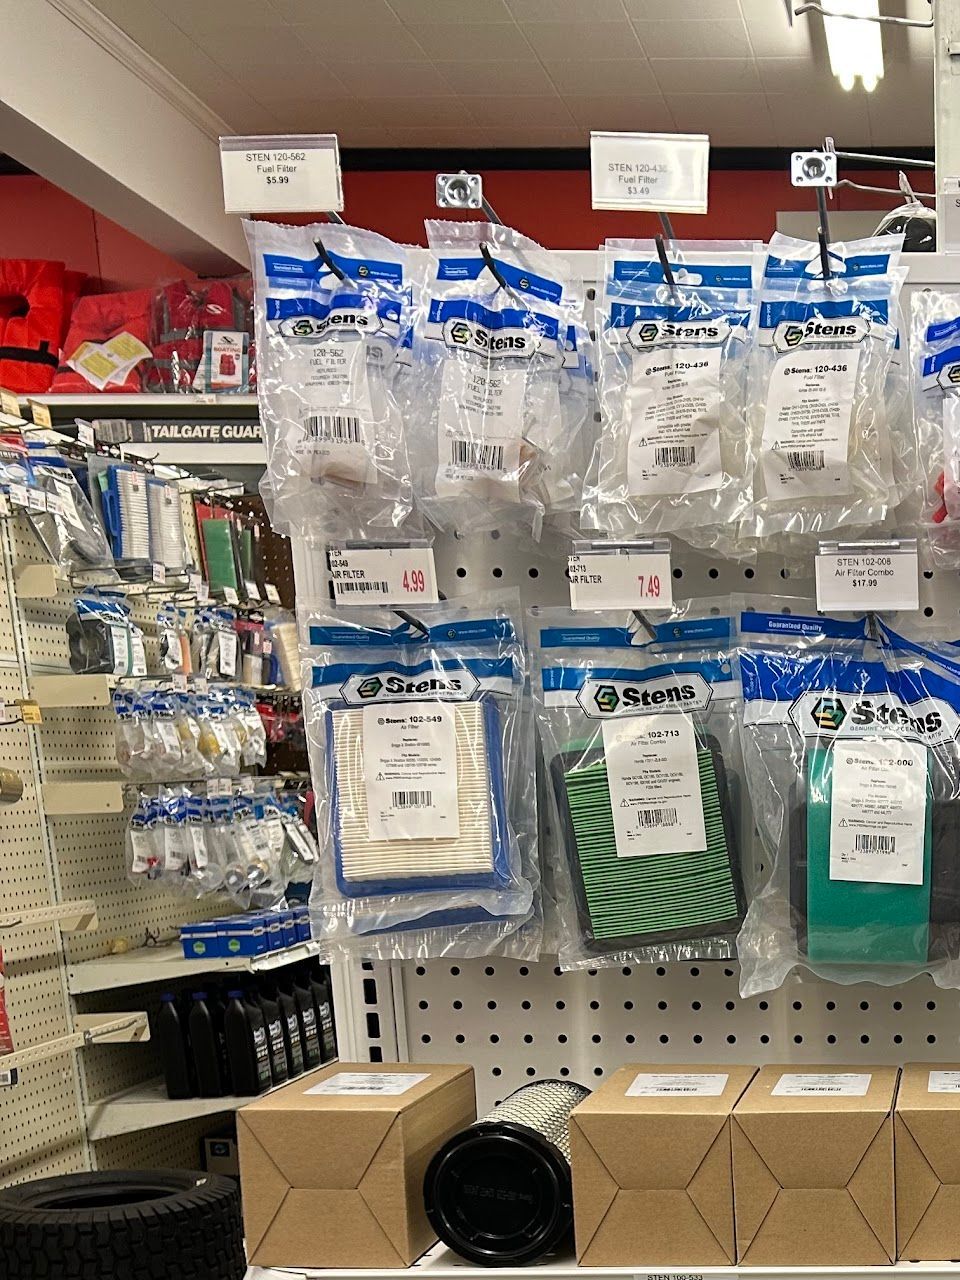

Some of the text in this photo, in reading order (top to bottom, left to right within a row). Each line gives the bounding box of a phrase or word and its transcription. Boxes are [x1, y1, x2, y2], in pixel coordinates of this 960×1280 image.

[246, 152, 306, 162] STEN 120-562
[257, 165, 297, 173] Fuel Filter
[608, 164, 632, 172] STEN
[266, 176, 288, 185] $5.99
[618, 175, 658, 184] Fuel Filter
[628, 187, 650, 195] $3.49
[316, 308, 369, 333] Stens
[662, 322, 719, 338] Stens
[804, 322, 857, 337] Stens
[474, 328, 526, 350] Stens
[313, 348, 344, 357] 120-562
[674, 361, 709, 370] 120-436
[814, 364, 848, 374] 120-436
[152, 425, 220, 438] TAILGATE
[836, 558, 892, 566] STEN 102-008
[342, 570, 366, 578] FILTER
[834, 568, 894, 577] Air Filter Combo
[402, 570, 425, 592] 4.99
[580, 574, 602, 584] FILTER
[852, 578, 878, 588] $17.99
[638, 575, 660, 598] 7.49
[385, 676, 462, 694] Stens
[622, 684, 696, 708] Stens
[850, 700, 943, 735] Stens
[648, 729, 680, 738] 102-713
